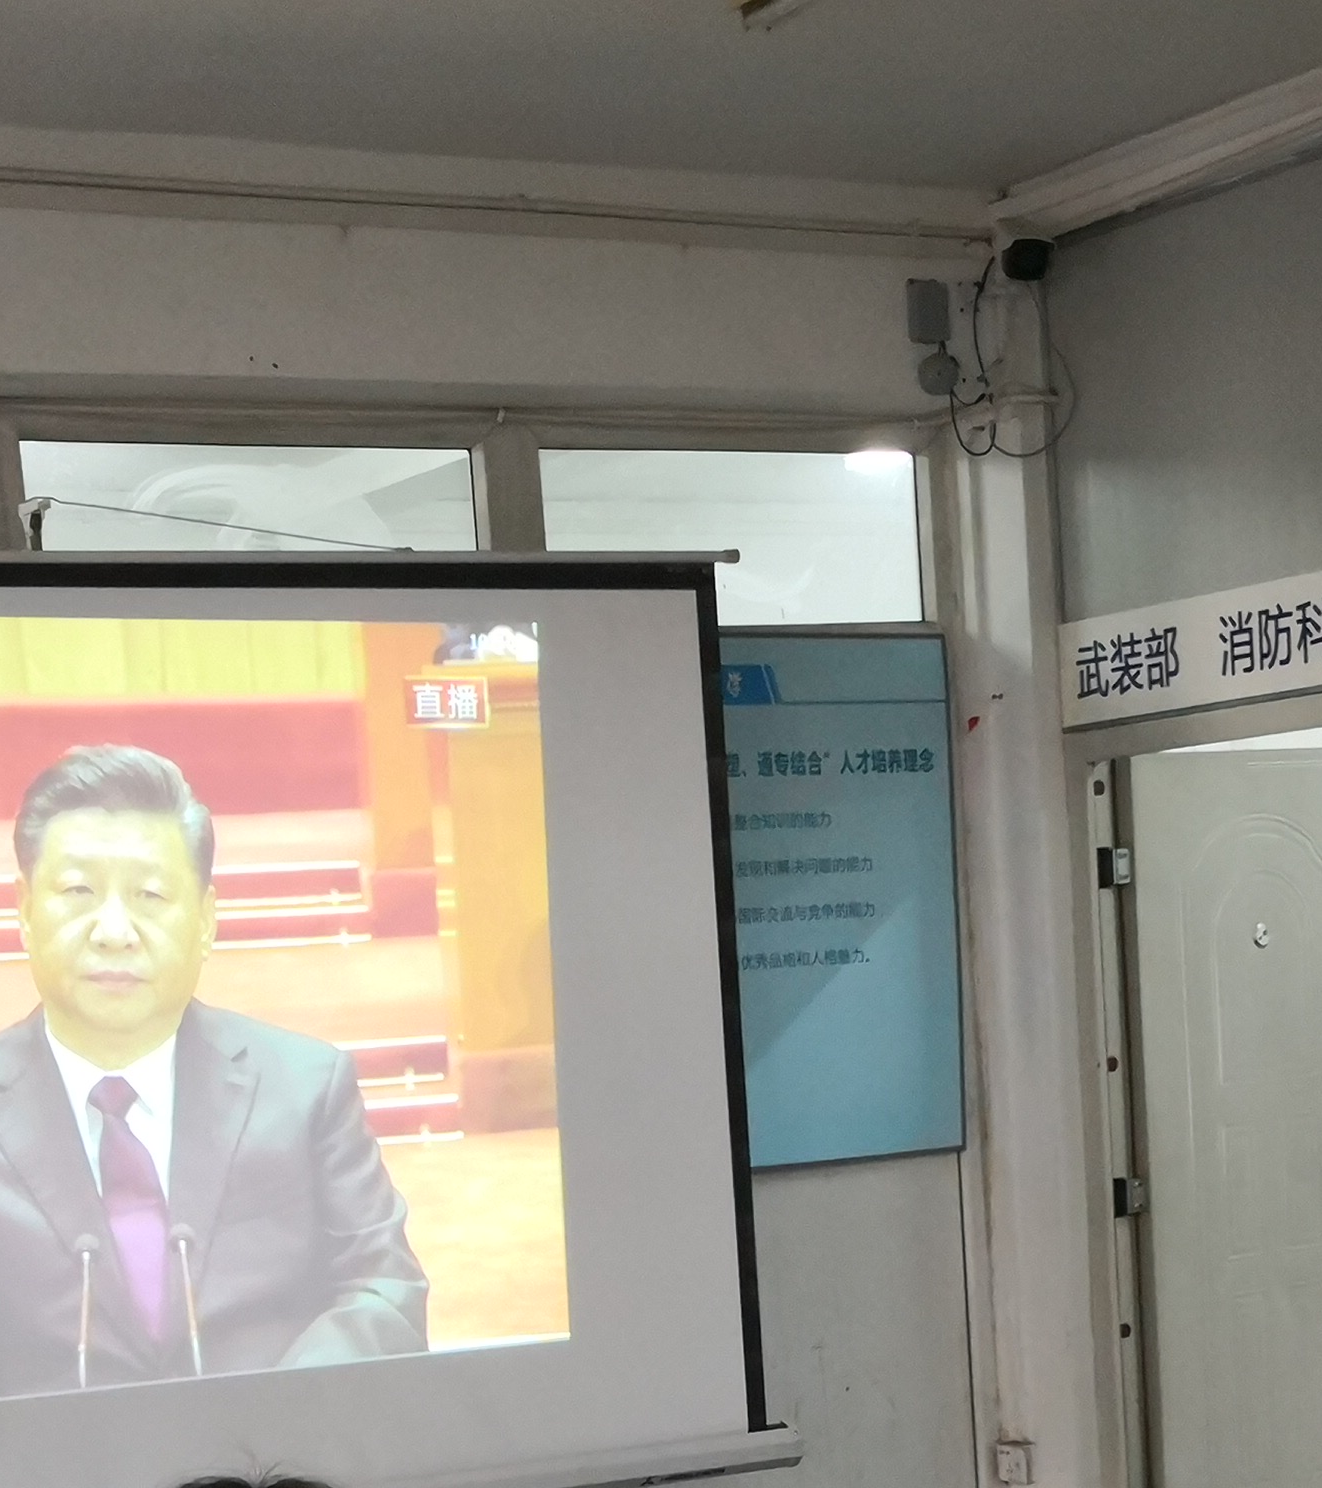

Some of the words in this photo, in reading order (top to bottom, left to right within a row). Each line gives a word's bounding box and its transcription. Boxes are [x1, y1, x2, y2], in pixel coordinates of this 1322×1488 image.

[1076, 627, 1180, 700] 武装部
[412, 682, 478, 720] 直播
